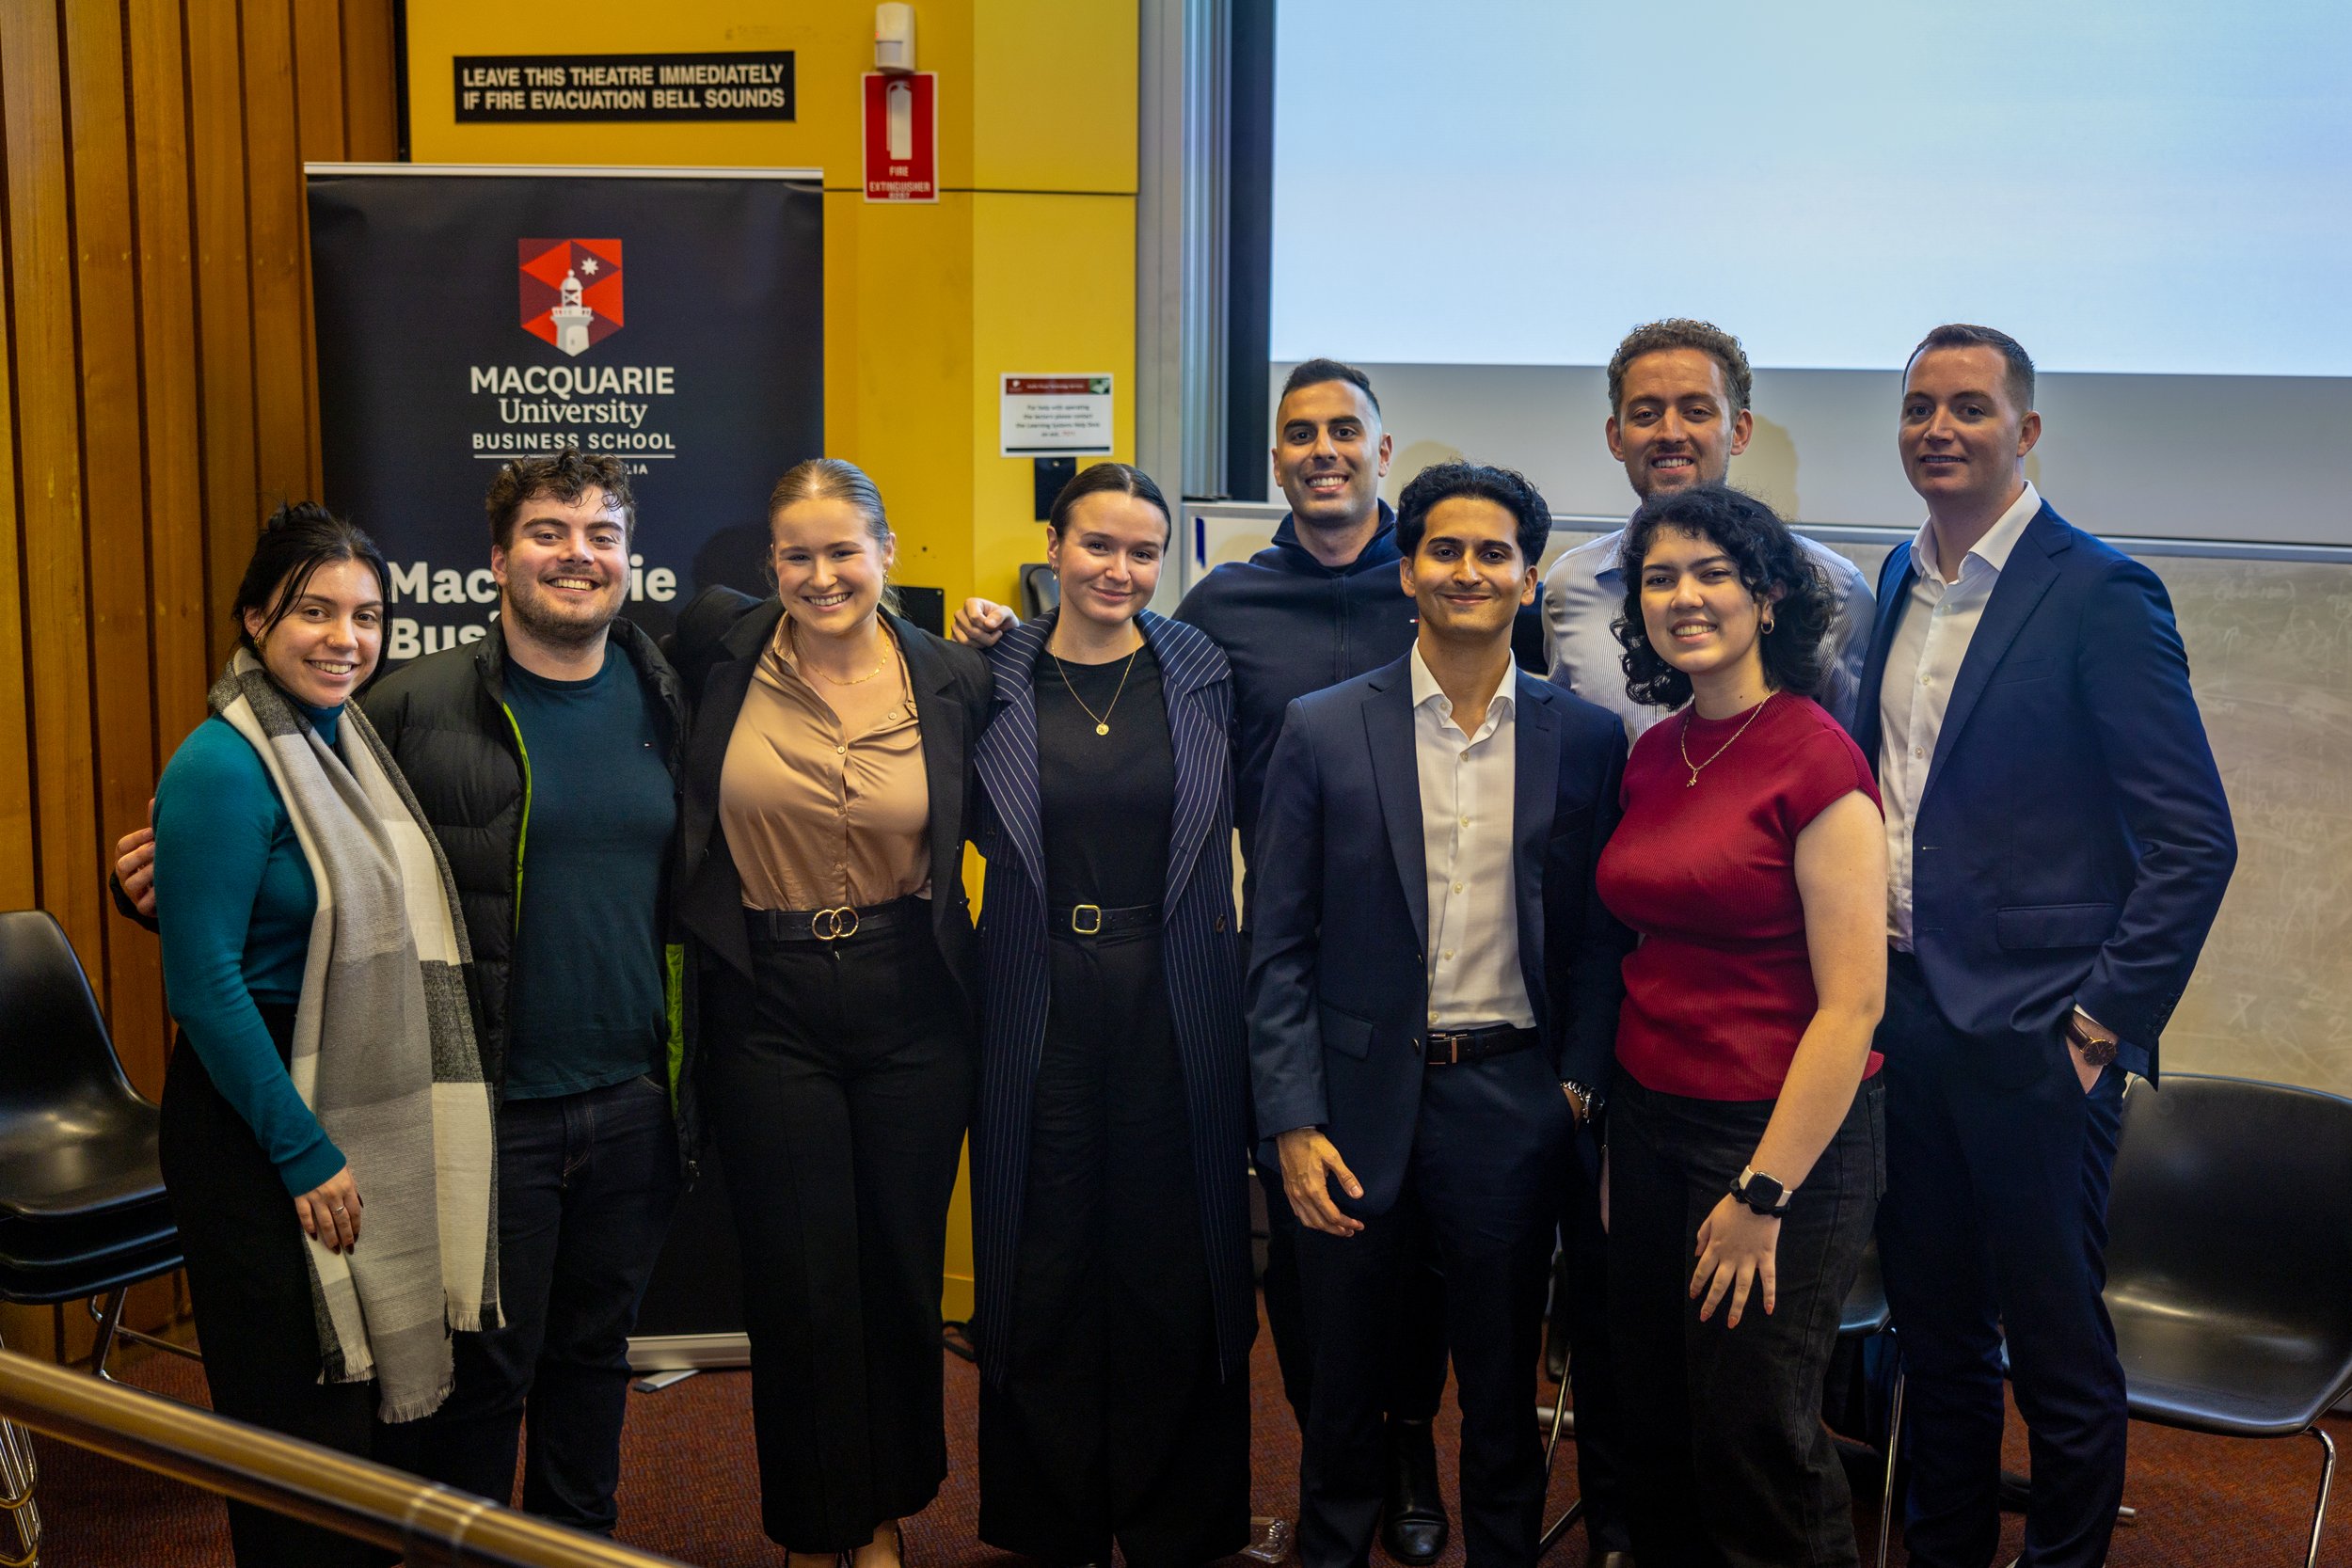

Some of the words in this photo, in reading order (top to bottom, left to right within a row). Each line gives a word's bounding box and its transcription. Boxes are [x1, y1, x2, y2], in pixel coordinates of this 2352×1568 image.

[463, 68, 520, 87] LEAVE
[524, 68, 565, 87] THIS
[569, 66, 654, 87] THEATRE
[660, 64, 784, 86] IMMEDIATELY
[463, 92, 481, 110] IF
[485, 91, 525, 110] FIRE
[531, 90, 646, 110] EVACUATION
[652, 89, 702, 109] BELL
[706, 88, 785, 109] SOUNDS
[888, 166, 910, 177] FIRE
[868, 181, 931, 192] EXTINGUISHER
[470, 365, 675, 401] MACQUARIE
[499, 397, 648, 429] University
[472, 433, 580, 450] BUSINESS
[588, 433, 676, 450] SCHOOL
[387, 554, 677, 604] Macie
